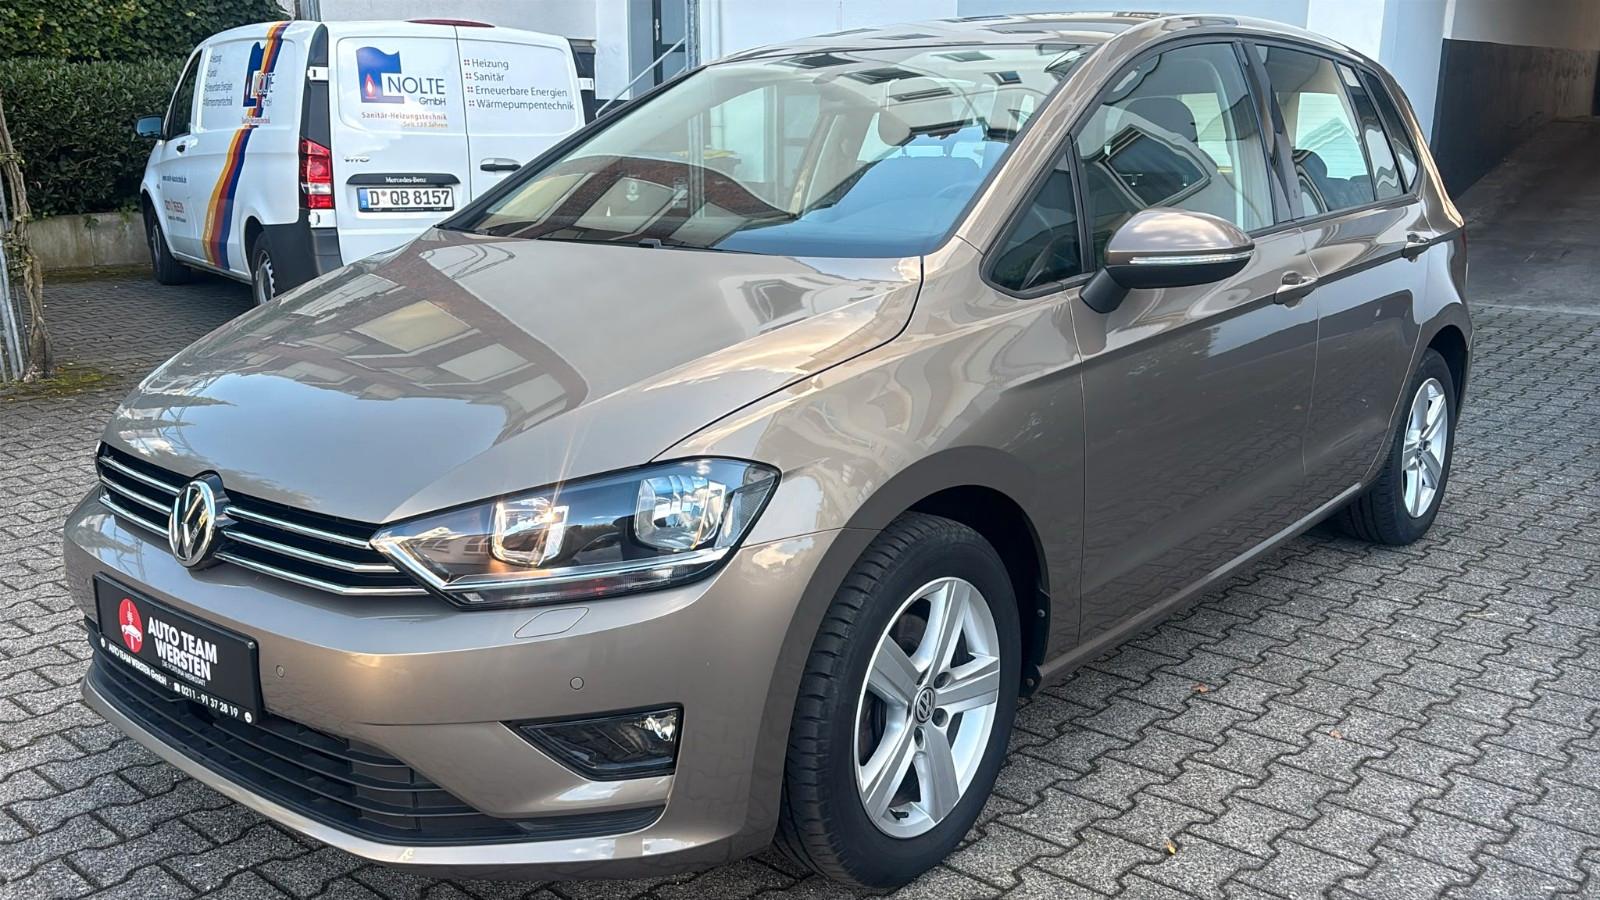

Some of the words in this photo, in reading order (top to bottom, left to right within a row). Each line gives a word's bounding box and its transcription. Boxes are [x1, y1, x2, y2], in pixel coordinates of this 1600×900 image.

[472, 58, 509, 70] Heizung
[473, 72, 505, 81] Sanitär
[387, 76, 446, 95] NOLTE
[475, 86, 529, 96] Erneuerbare
[531, 87, 568, 98] Energien
[418, 96, 447, 106] GmbH
[476, 99, 575, 111] Wärmepumpentechnik
[369, 190, 380, 206] D
[389, 190, 411, 206] QB
[413, 190, 450, 206] 8157
[148, 616, 180, 647] AUTO
[180, 630, 218, 665] TEAM
[154, 637, 211, 681] WERSTEN
[181, 685, 196, 700] 0211
[200, 693, 209, 706] 91
[210, 698, 218, 710] 37
[229, 705, 239, 718] 19
